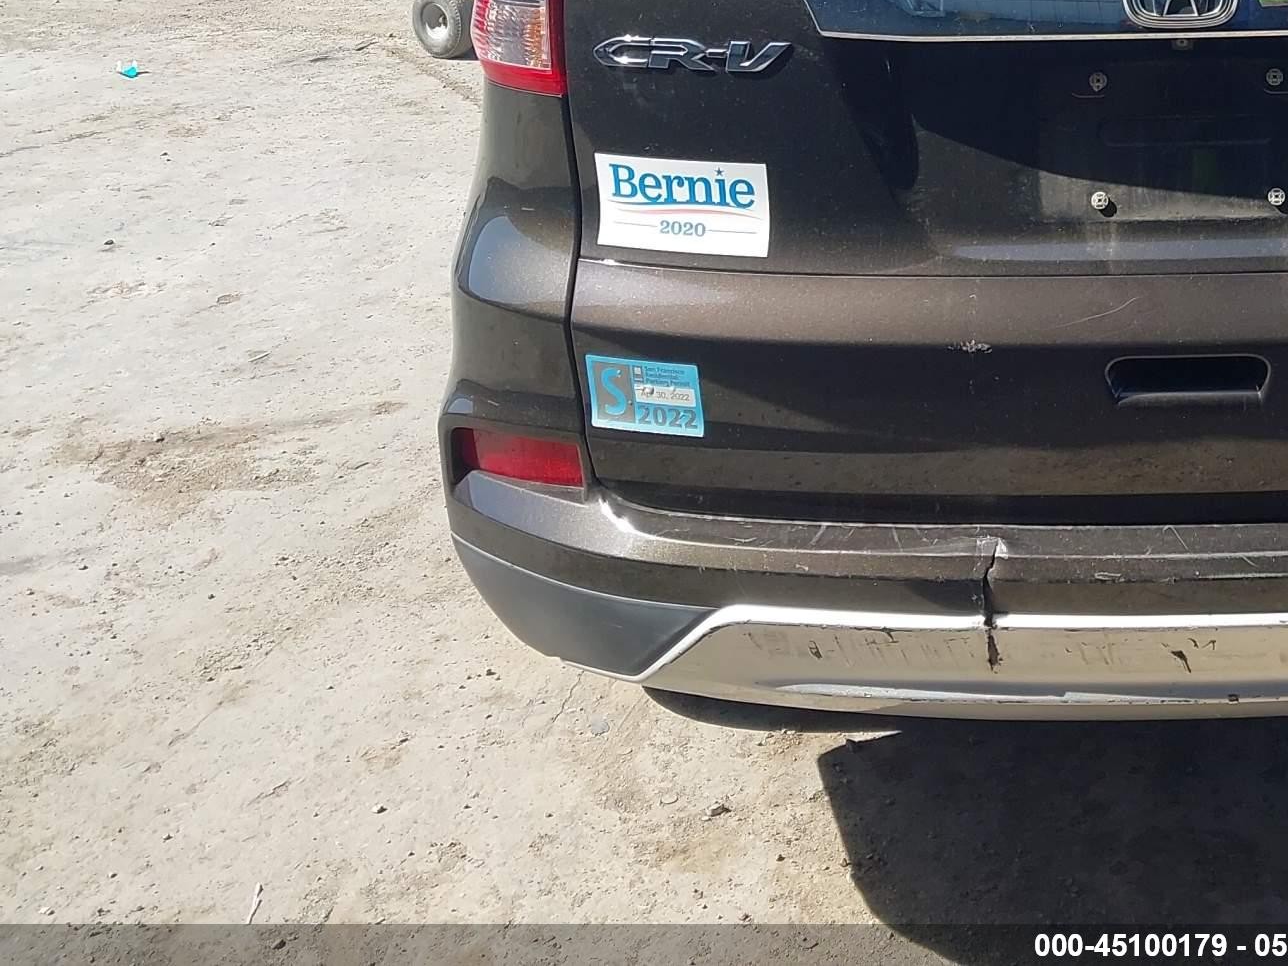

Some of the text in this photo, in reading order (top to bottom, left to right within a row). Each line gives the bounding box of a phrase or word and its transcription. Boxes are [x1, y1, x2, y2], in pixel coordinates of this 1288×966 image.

[593, 35, 793, 73] CR-V
[609, 163, 756, 209] Bernie
[659, 219, 706, 237] 2020
[670, 392, 690, 402] 2022
[637, 406, 698, 430] 2022
